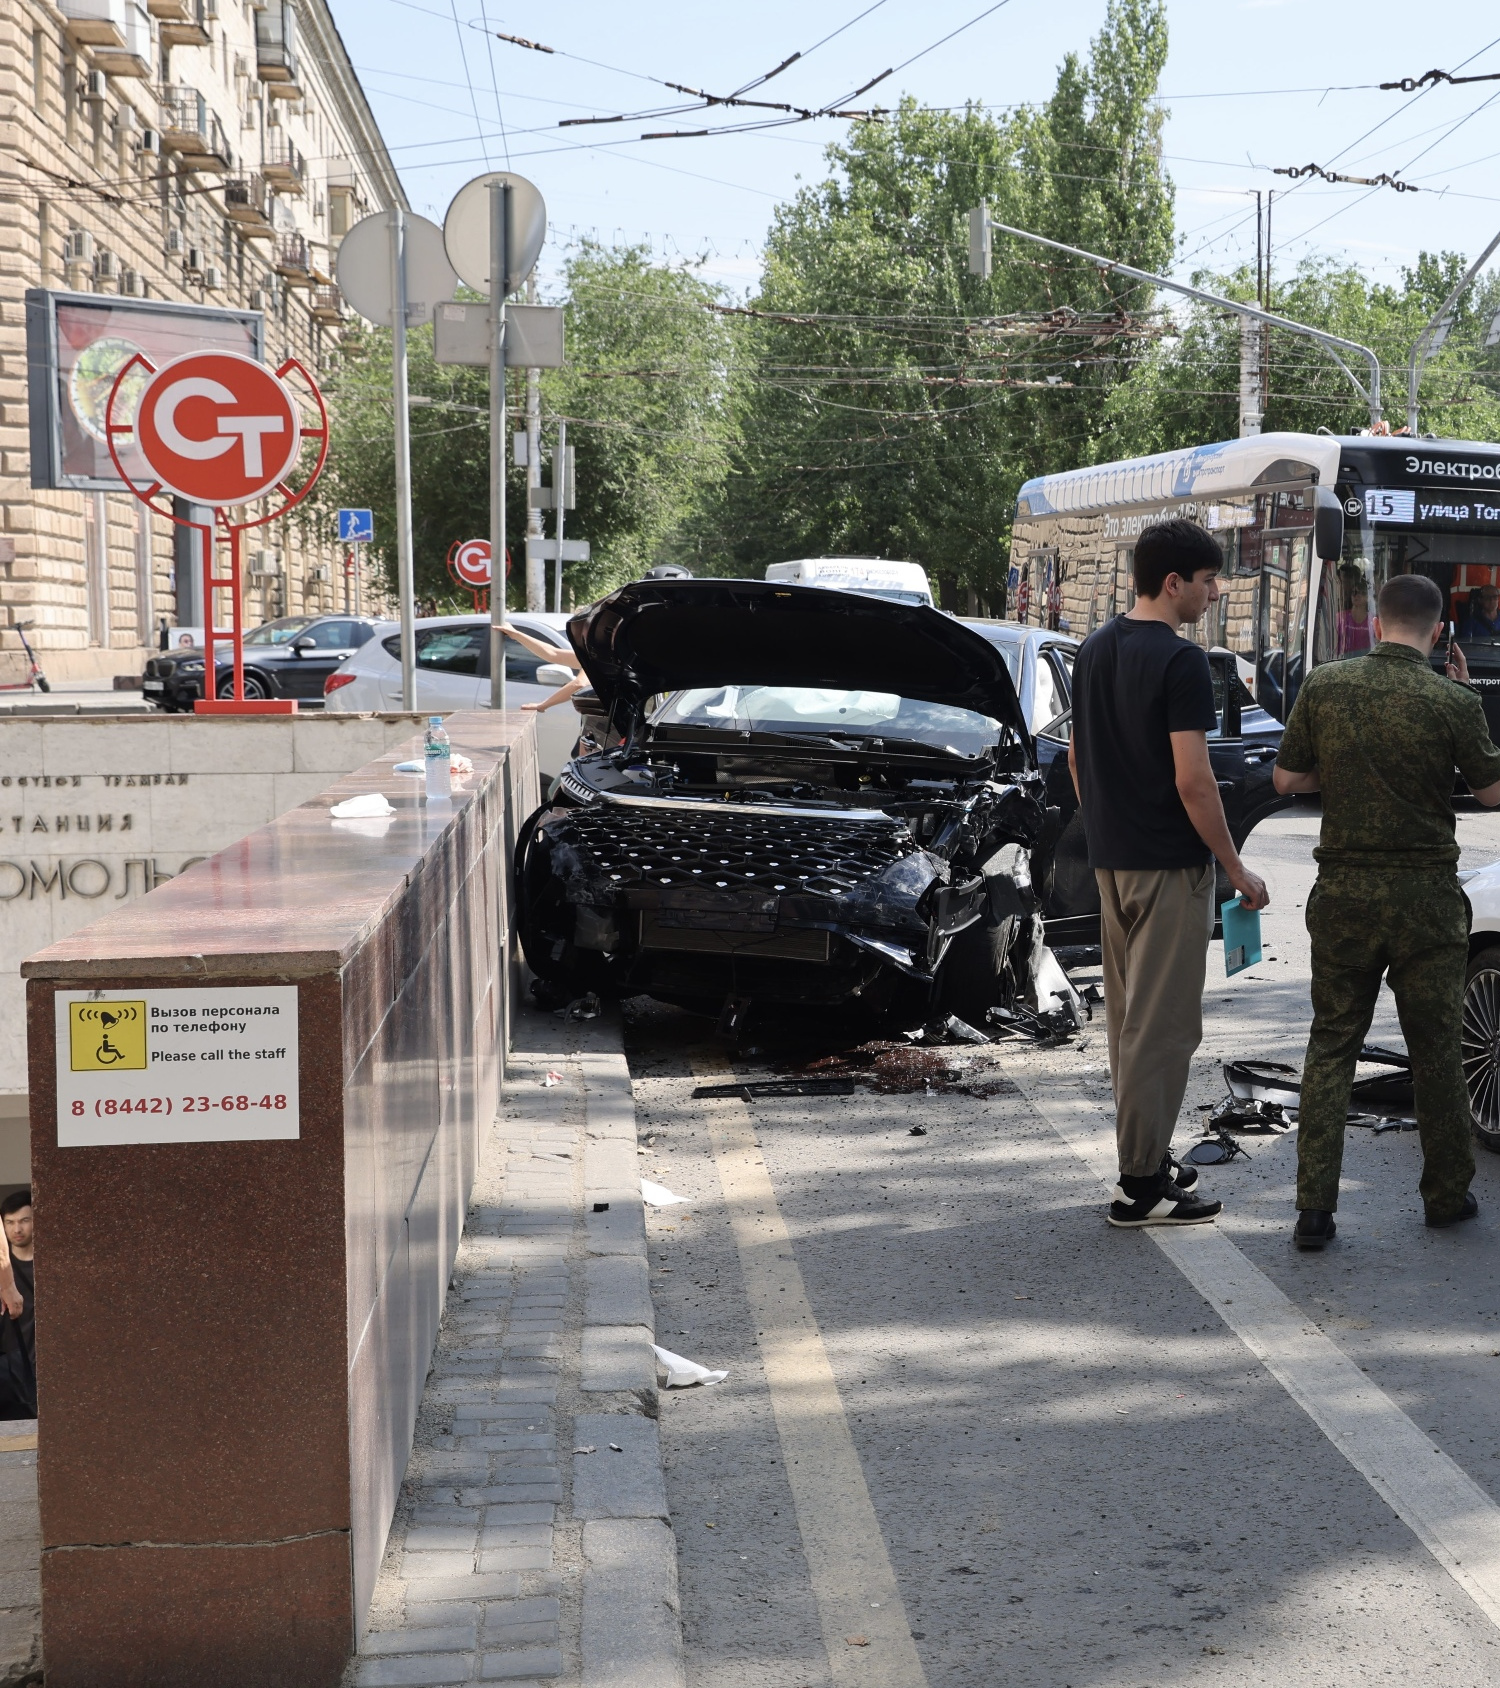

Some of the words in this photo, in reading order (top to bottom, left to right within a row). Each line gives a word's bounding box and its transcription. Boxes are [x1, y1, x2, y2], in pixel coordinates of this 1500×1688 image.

[1367, 493, 1395, 516] 15
[1419, 503, 1469, 521] улица
[1103, 513, 1119, 538] Это
[0, 856, 210, 901] ОМОЛЬ
[151, 1007, 197, 1018] Вызов
[201, 1006, 280, 1019] персонала
[151, 1024, 169, 1033] по
[173, 1021, 247, 1034] телефону
[151, 1050, 196, 1062] Please
[200, 1049, 224, 1061] call
[228, 1048, 251, 1060] the
[254, 1047, 287, 1060] staff
[71, 1100, 85, 1116] 8
[94, 1097, 173, 1118] (8442)
[182, 1094, 288, 1113] 23-68-48
